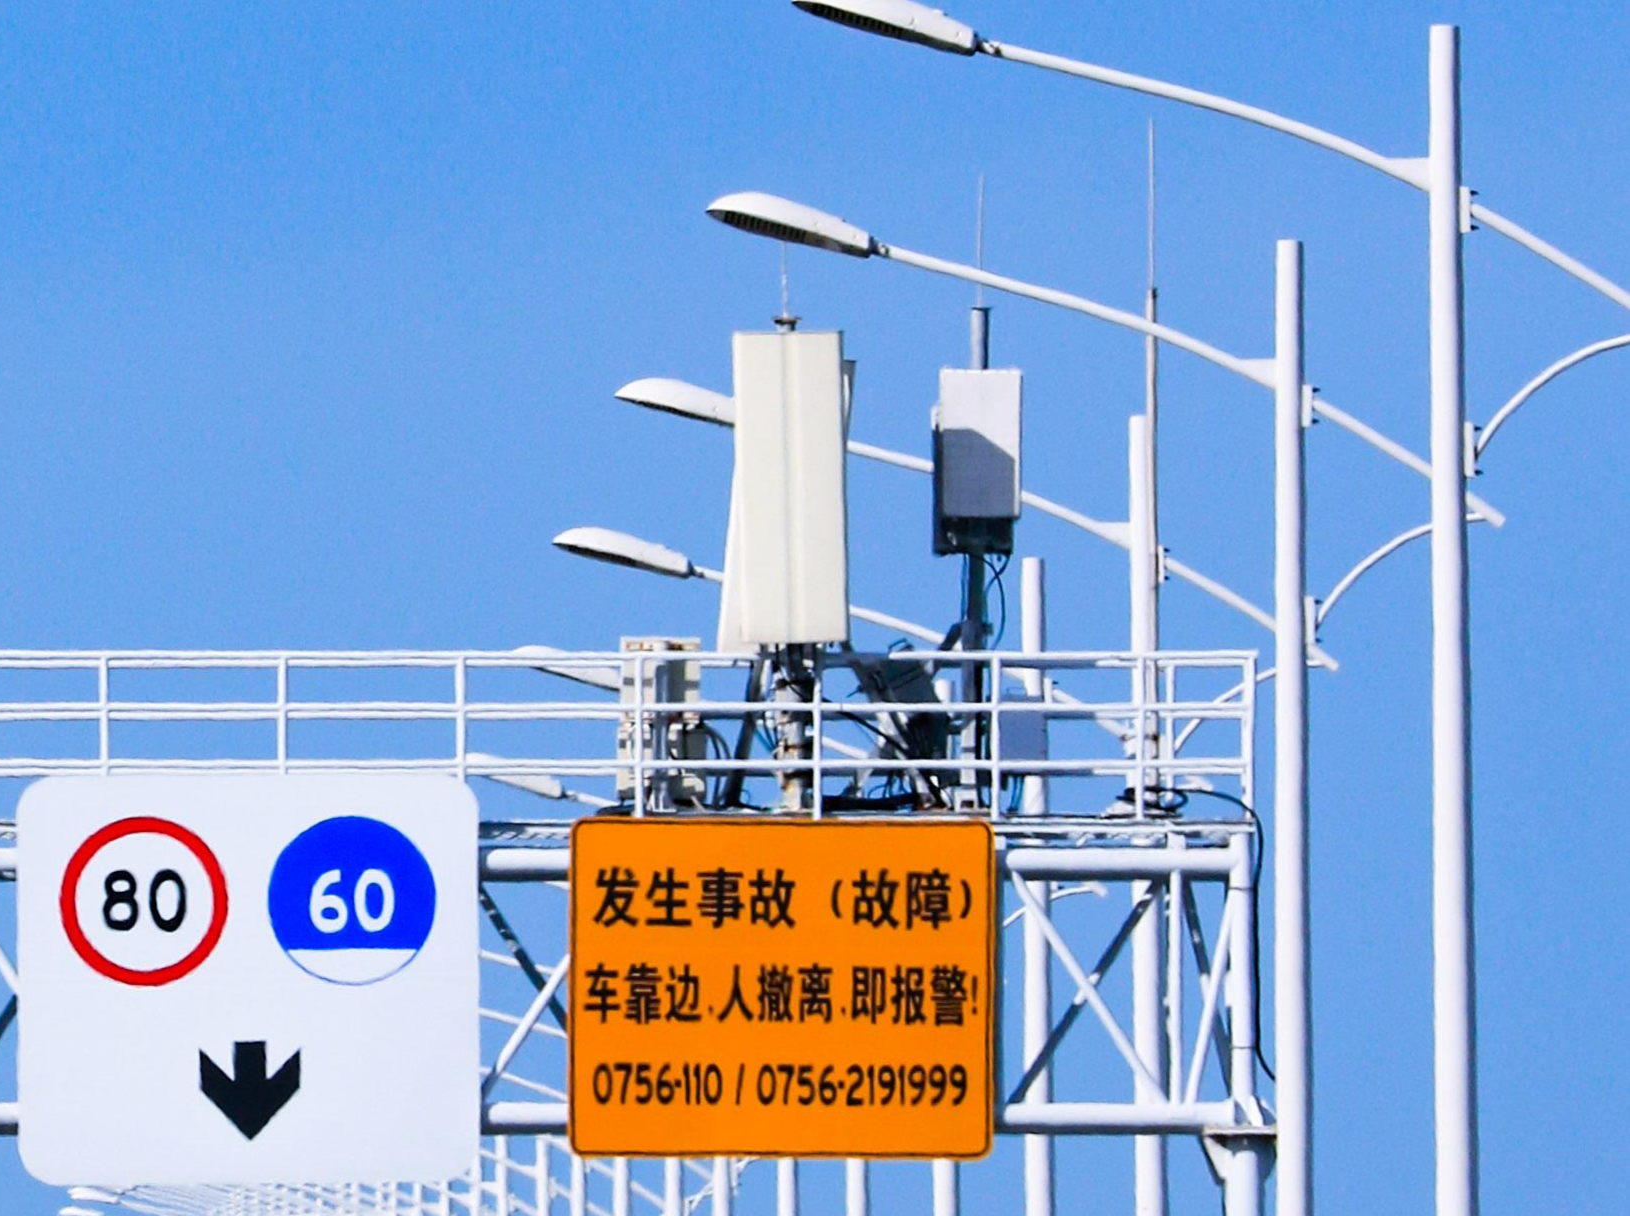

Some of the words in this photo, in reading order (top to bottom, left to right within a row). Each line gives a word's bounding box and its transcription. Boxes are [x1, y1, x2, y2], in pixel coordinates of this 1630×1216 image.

[103, 869, 187, 932] 80
[309, 868, 396, 934] 60
[756, 1064, 968, 1107] 0756-2191999
